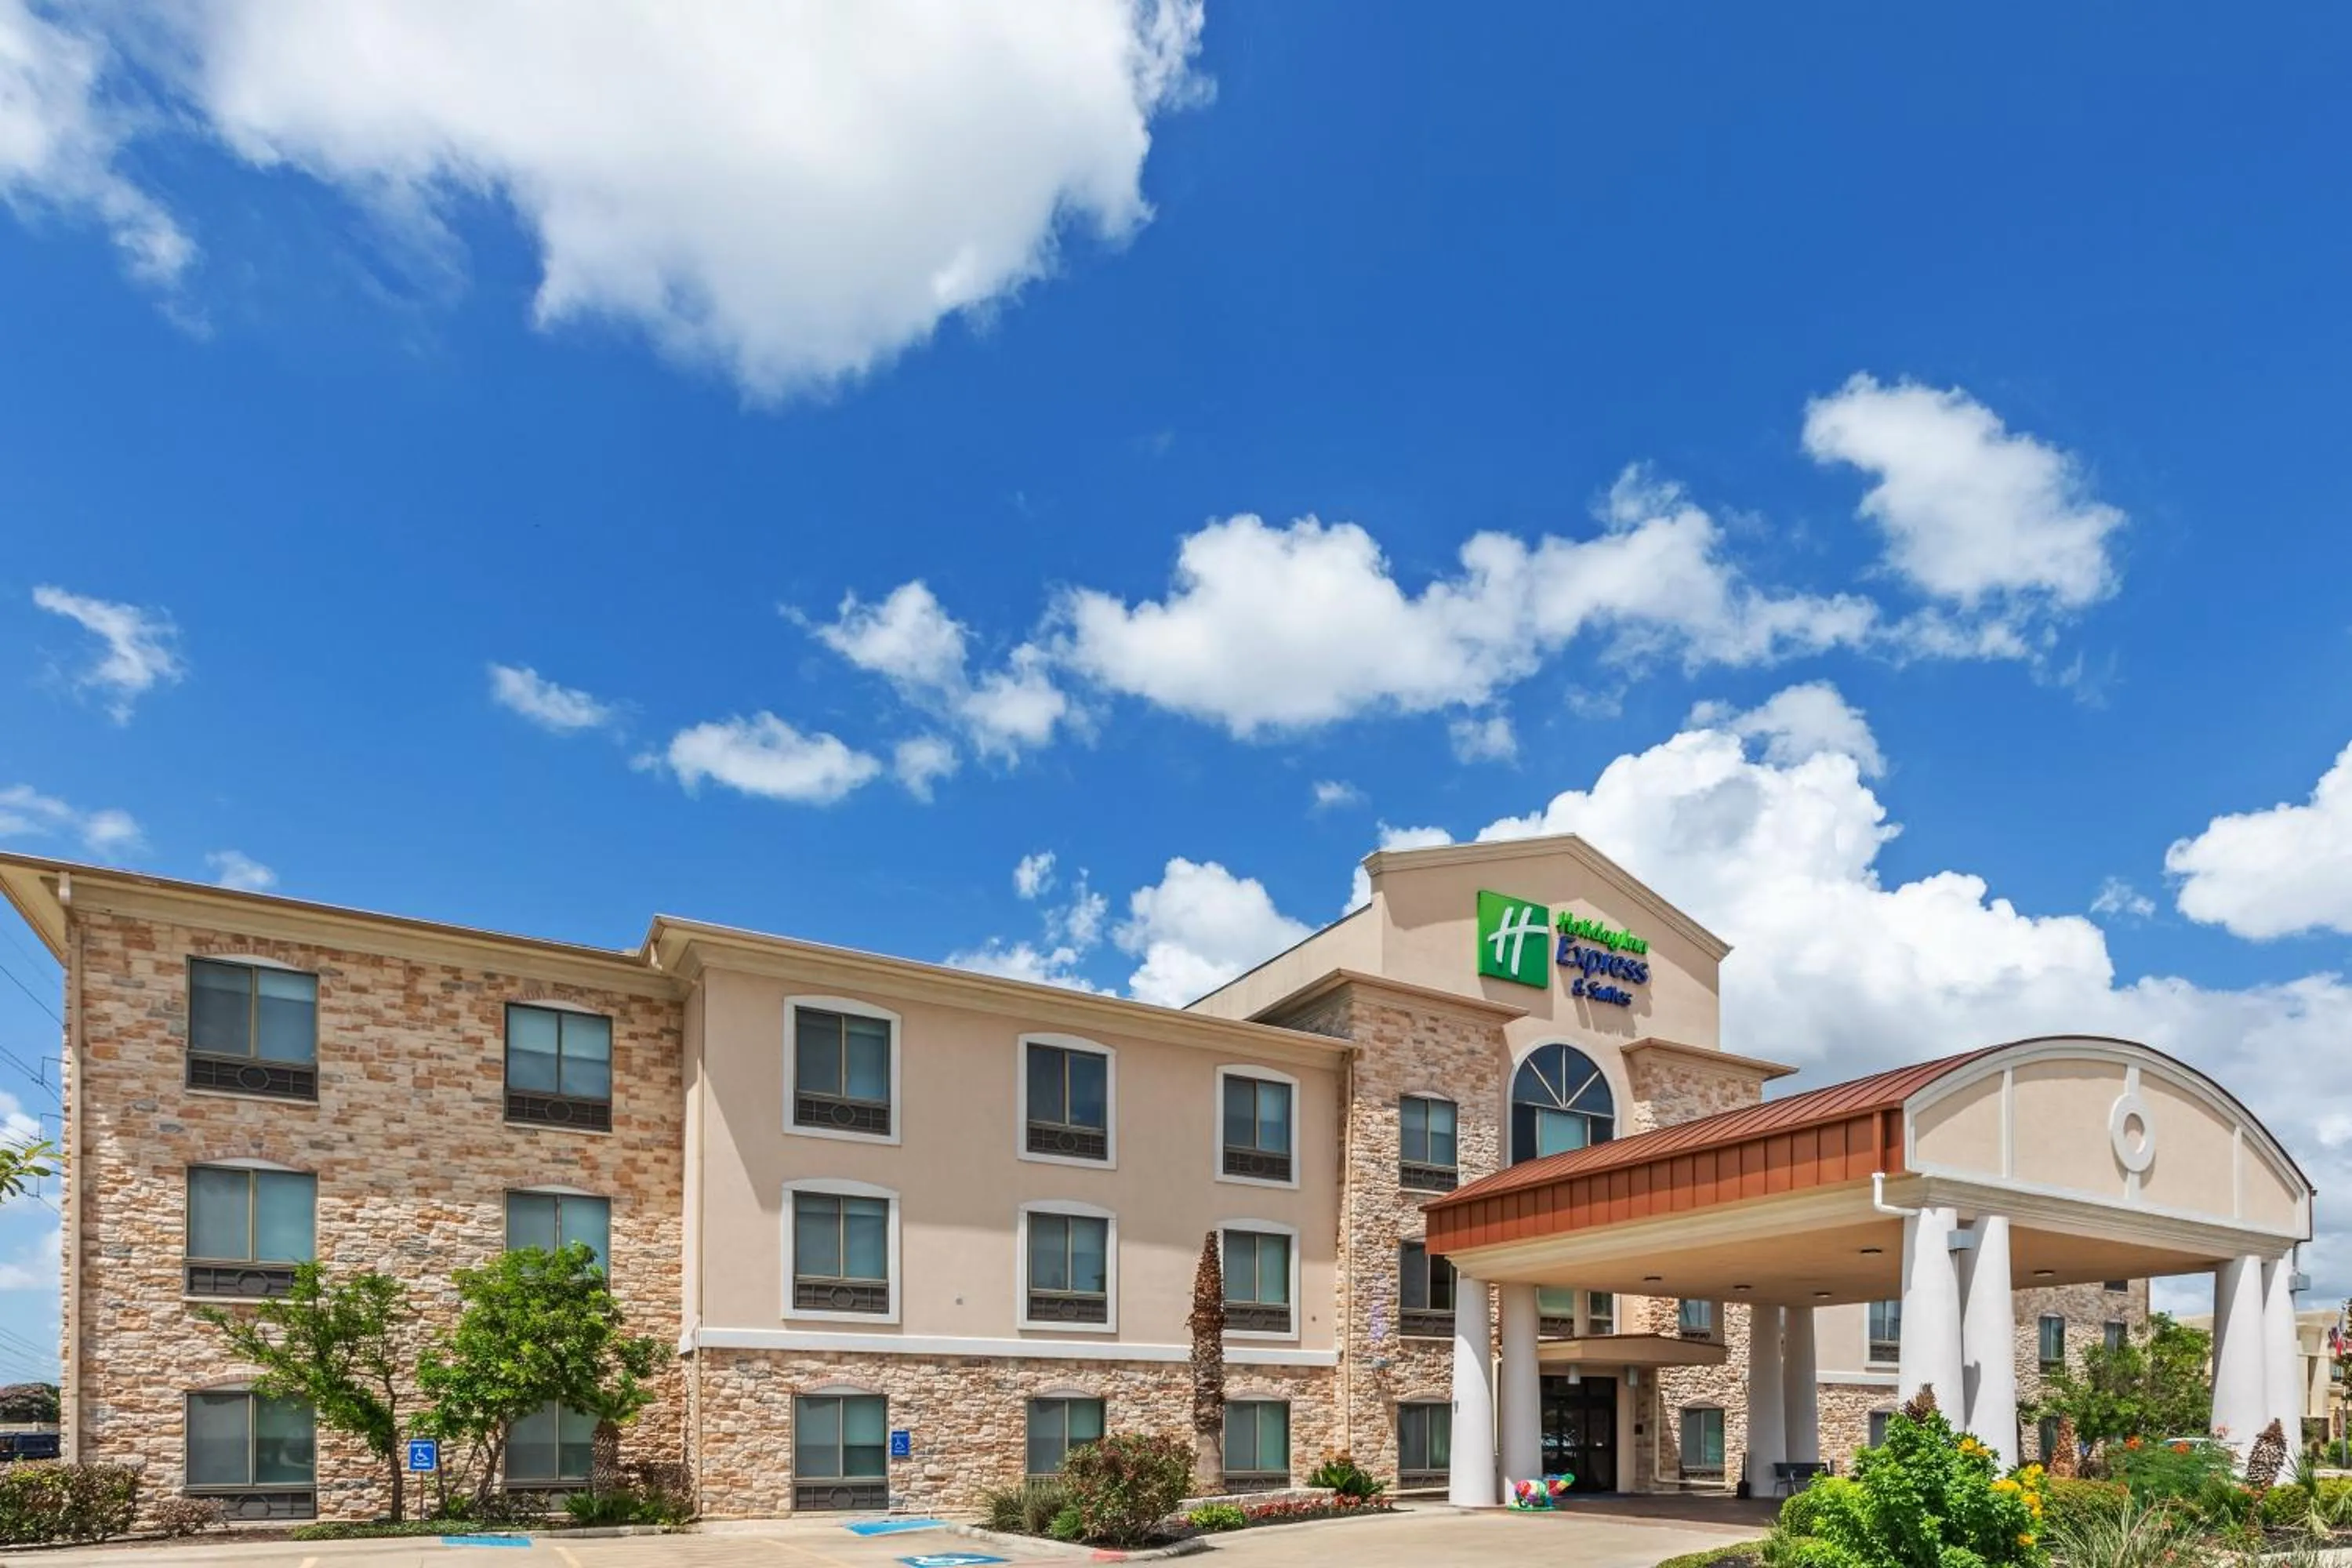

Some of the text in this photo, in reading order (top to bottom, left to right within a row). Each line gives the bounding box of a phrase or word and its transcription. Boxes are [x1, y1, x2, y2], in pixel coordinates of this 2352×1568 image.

[1556, 935, 1649, 985] Express
[1571, 978, 1632, 1007] & Suites
